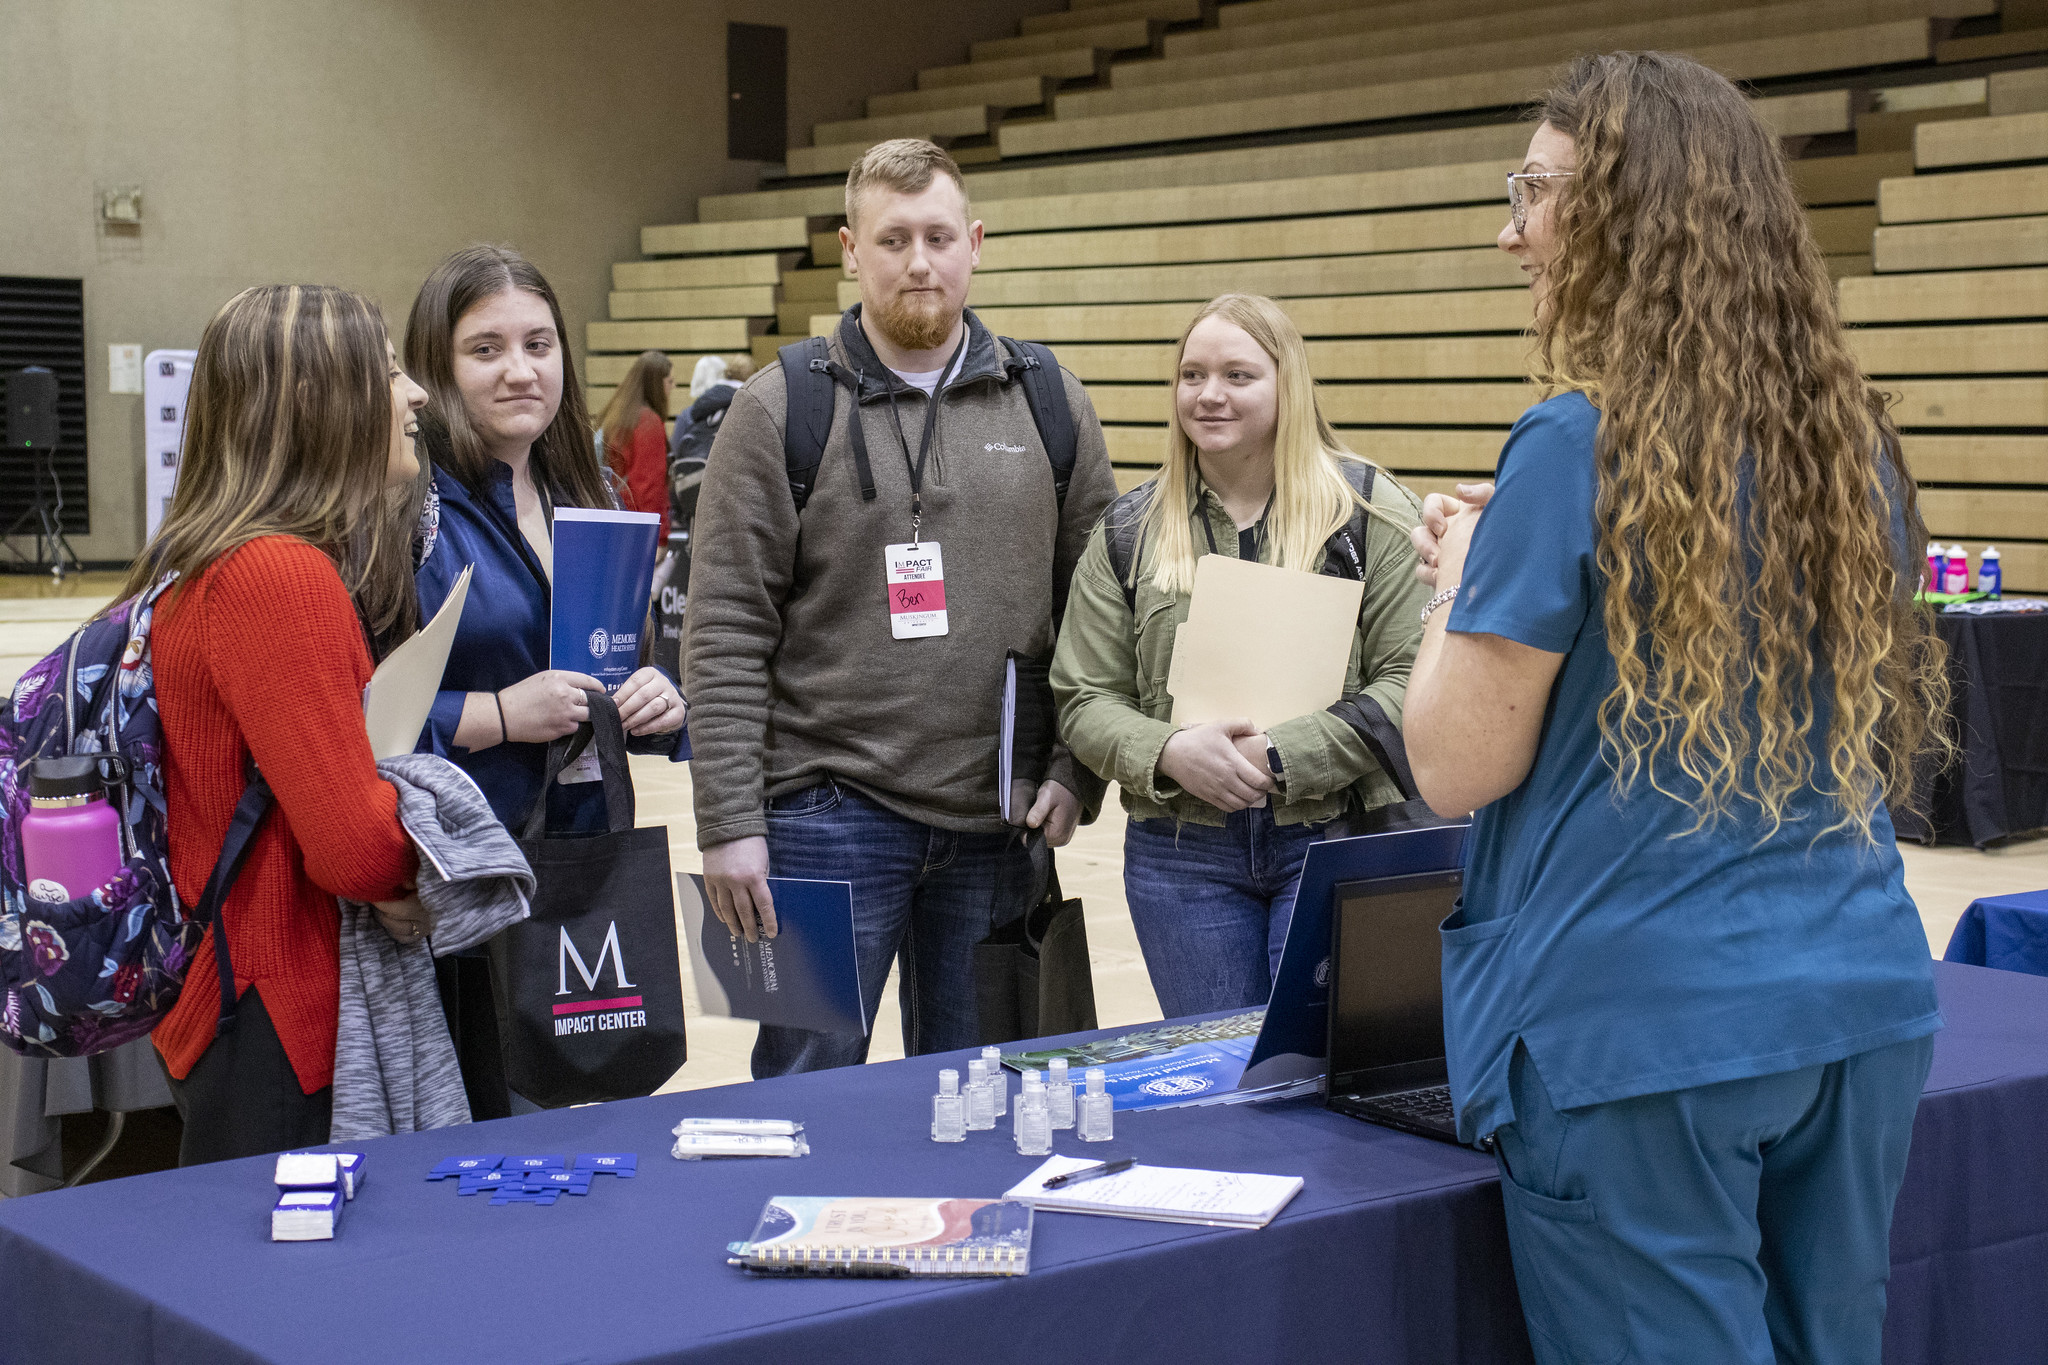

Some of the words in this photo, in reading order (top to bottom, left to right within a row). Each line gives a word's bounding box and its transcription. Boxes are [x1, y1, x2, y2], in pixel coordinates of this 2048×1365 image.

[894, 558, 933, 569] IMPACT
[915, 565, 933, 573] FAIR
[903, 573, 926, 581] ATTENDEE
[896, 588, 925, 609] Ben
[899, 613, 937, 622] MUSKINGUM
[555, 920, 637, 996] M
[554, 1015, 596, 1037] IMPACT
[597, 1010, 647, 1032] CENTER
[1162, 1058, 1222, 1074] Memorial
